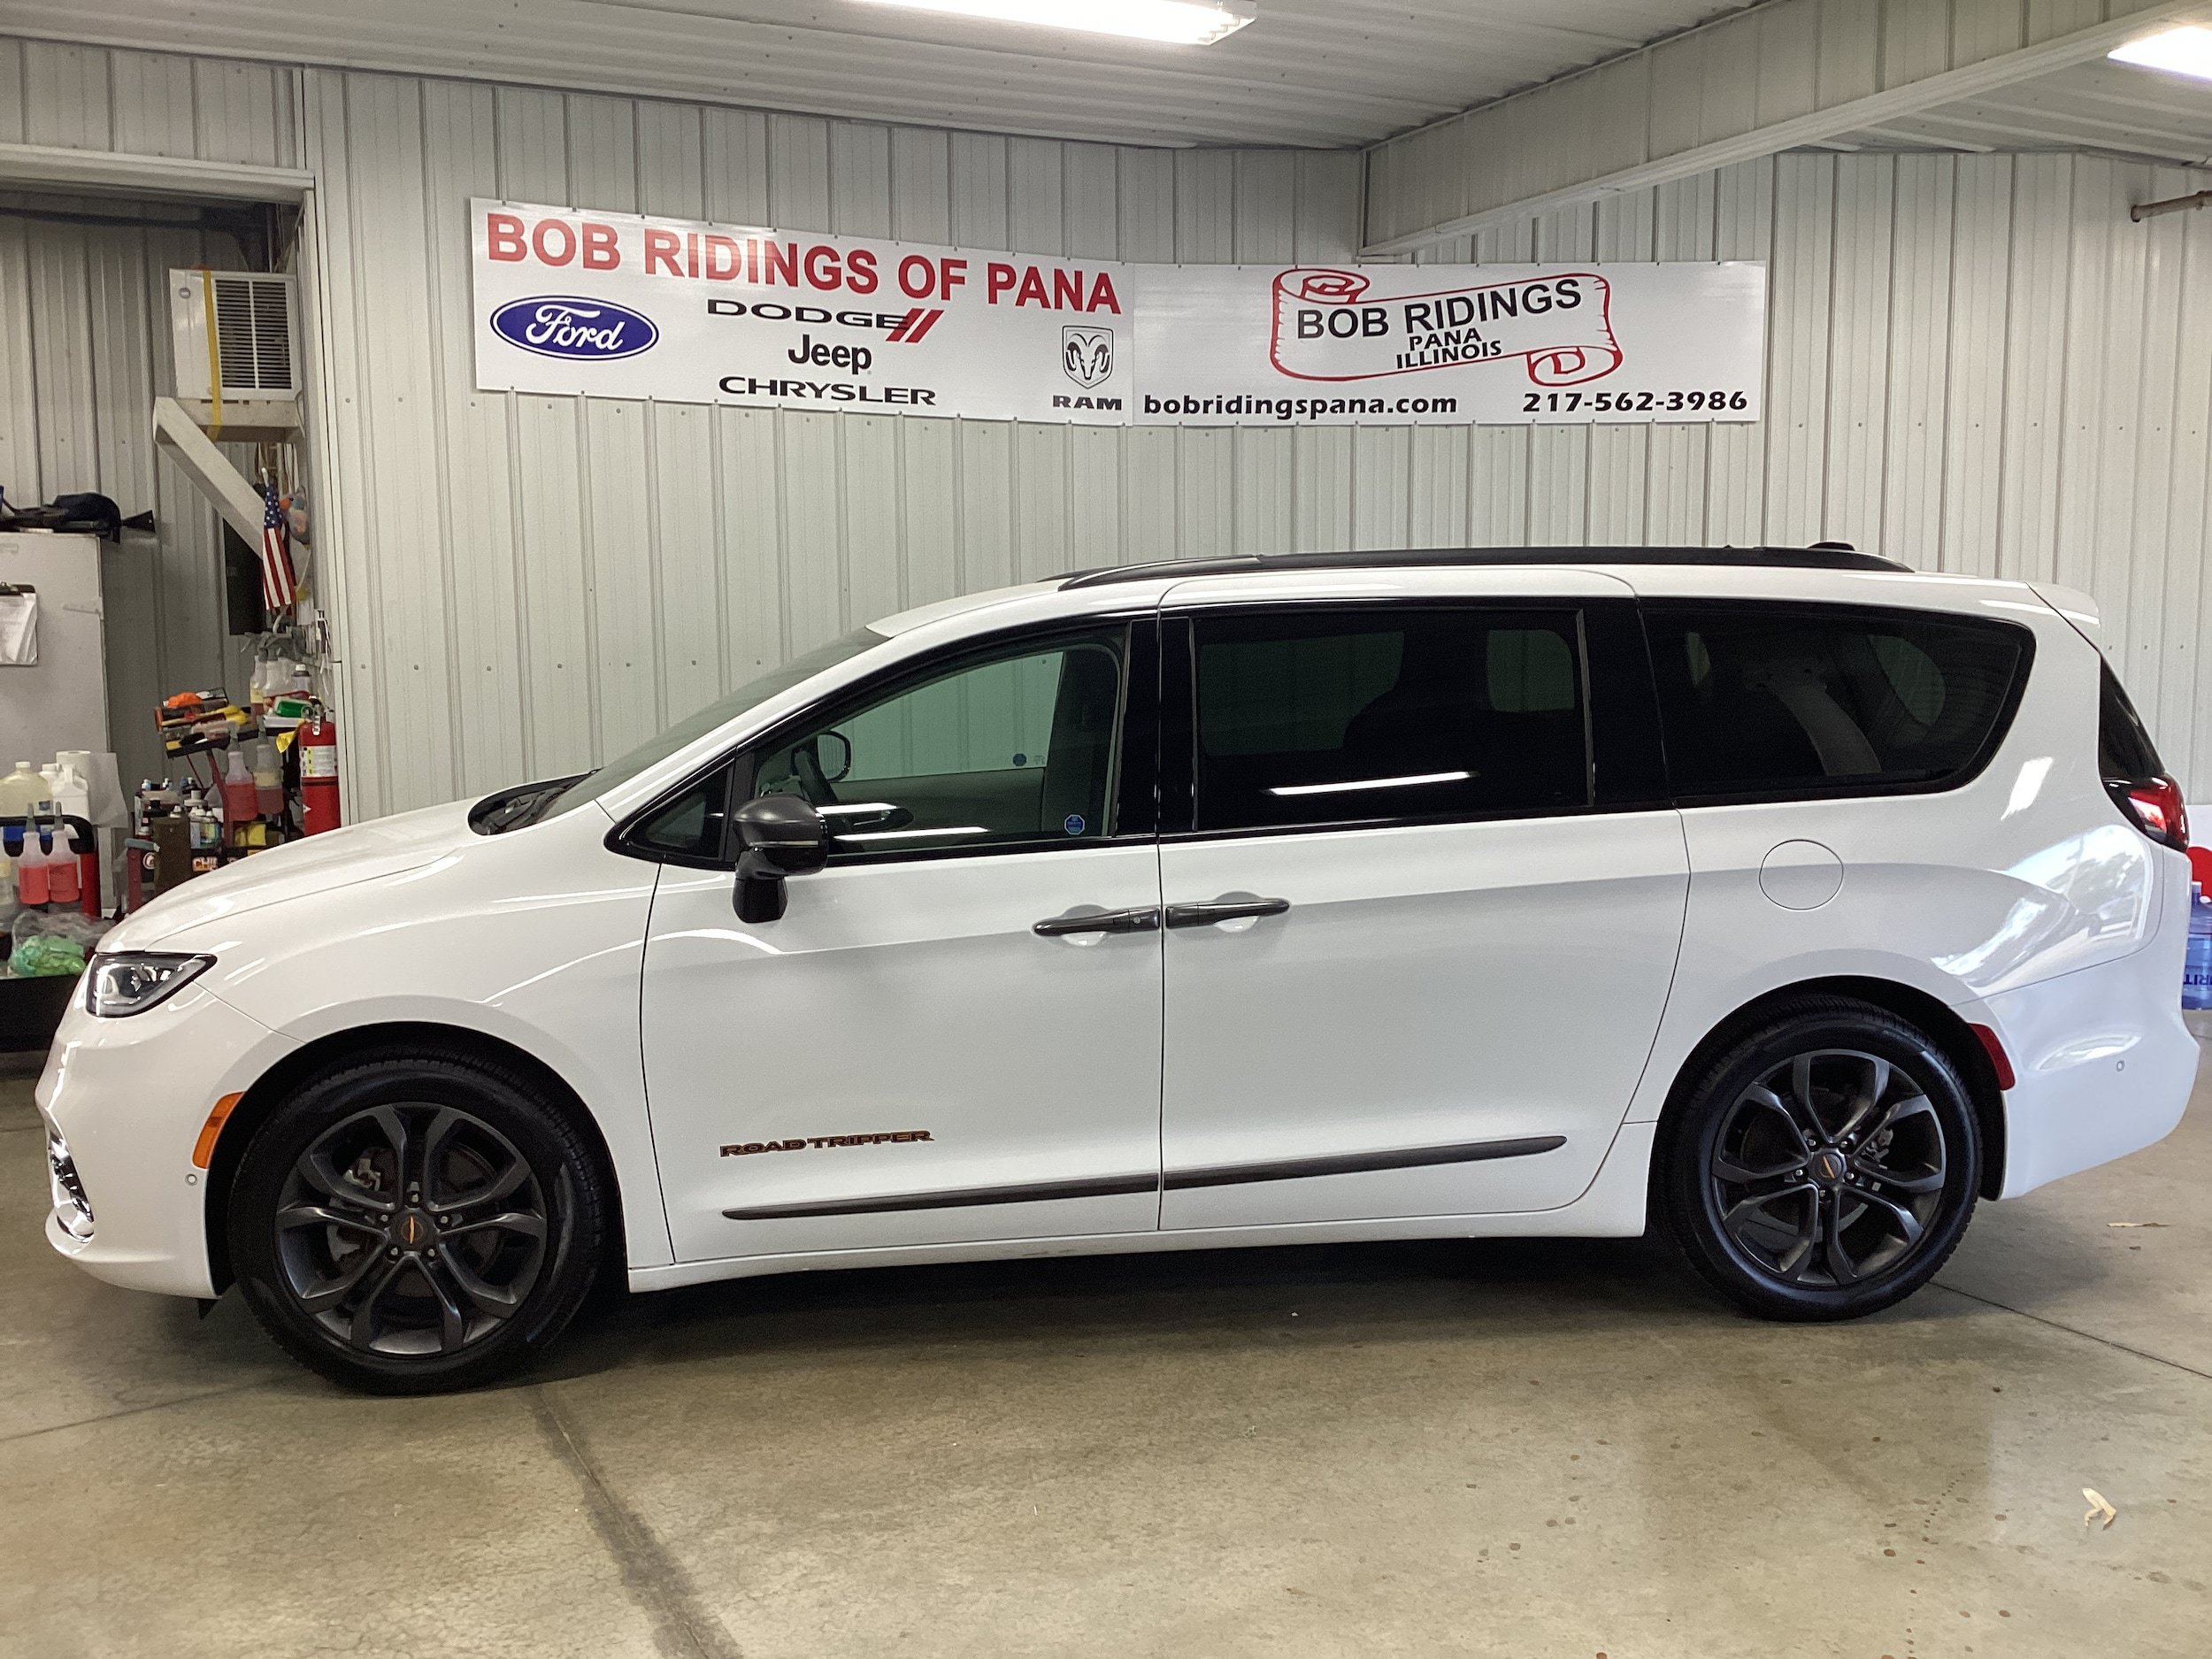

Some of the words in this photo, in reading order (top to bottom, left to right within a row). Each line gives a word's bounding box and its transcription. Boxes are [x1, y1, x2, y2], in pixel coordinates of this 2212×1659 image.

[487, 212, 621, 271] BOB
[643, 228, 879, 296] RIDINGS
[897, 254, 969, 301] OF
[987, 261, 1121, 315] PANA
[707, 298, 911, 330] DODGE
[1297, 307, 1389, 339] BOB
[1404, 279, 1582, 334] RIDINGS
[524, 303, 625, 350] Ford
[1409, 327, 1483, 352] PANA
[787, 334, 873, 375] Jeep
[1396, 340, 1502, 370] ILLINOIS
[718, 376, 936, 406] CHRYSLER
[1052, 395, 1122, 411] RAM
[1522, 390, 1747, 412] 217-562-3986
[1143, 395, 1457, 420] bobridingspana.com
[719, 1139, 807, 1157] ROAD
[806, 1130, 935, 1149] TRIPPER
